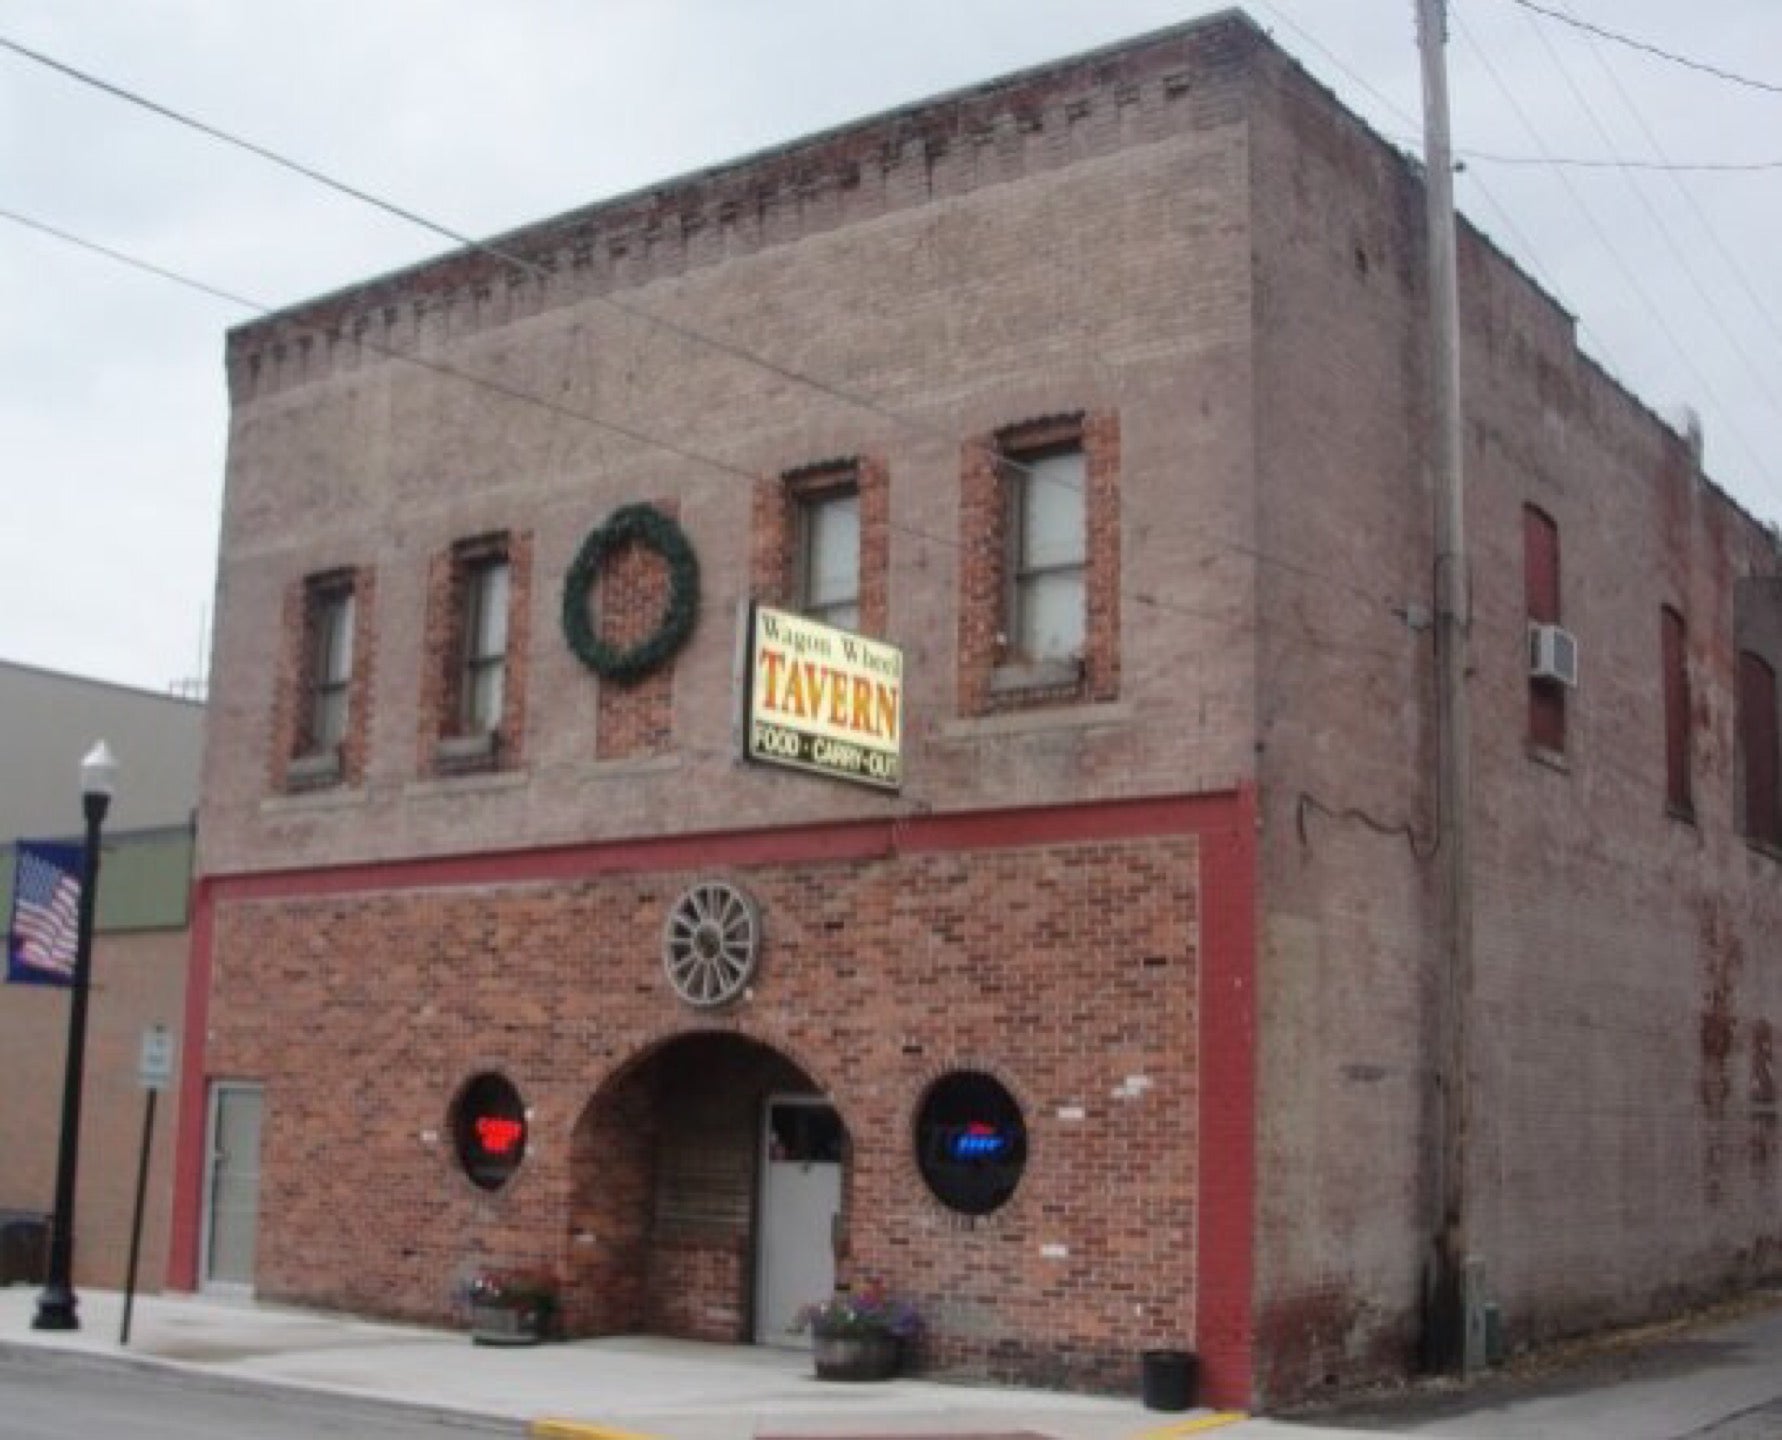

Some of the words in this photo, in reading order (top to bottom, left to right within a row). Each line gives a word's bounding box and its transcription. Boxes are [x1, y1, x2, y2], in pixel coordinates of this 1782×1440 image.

[761, 613, 832, 657] Wagon
[760, 646, 898, 740] TAVERN
[755, 724, 800, 758] FOOD
